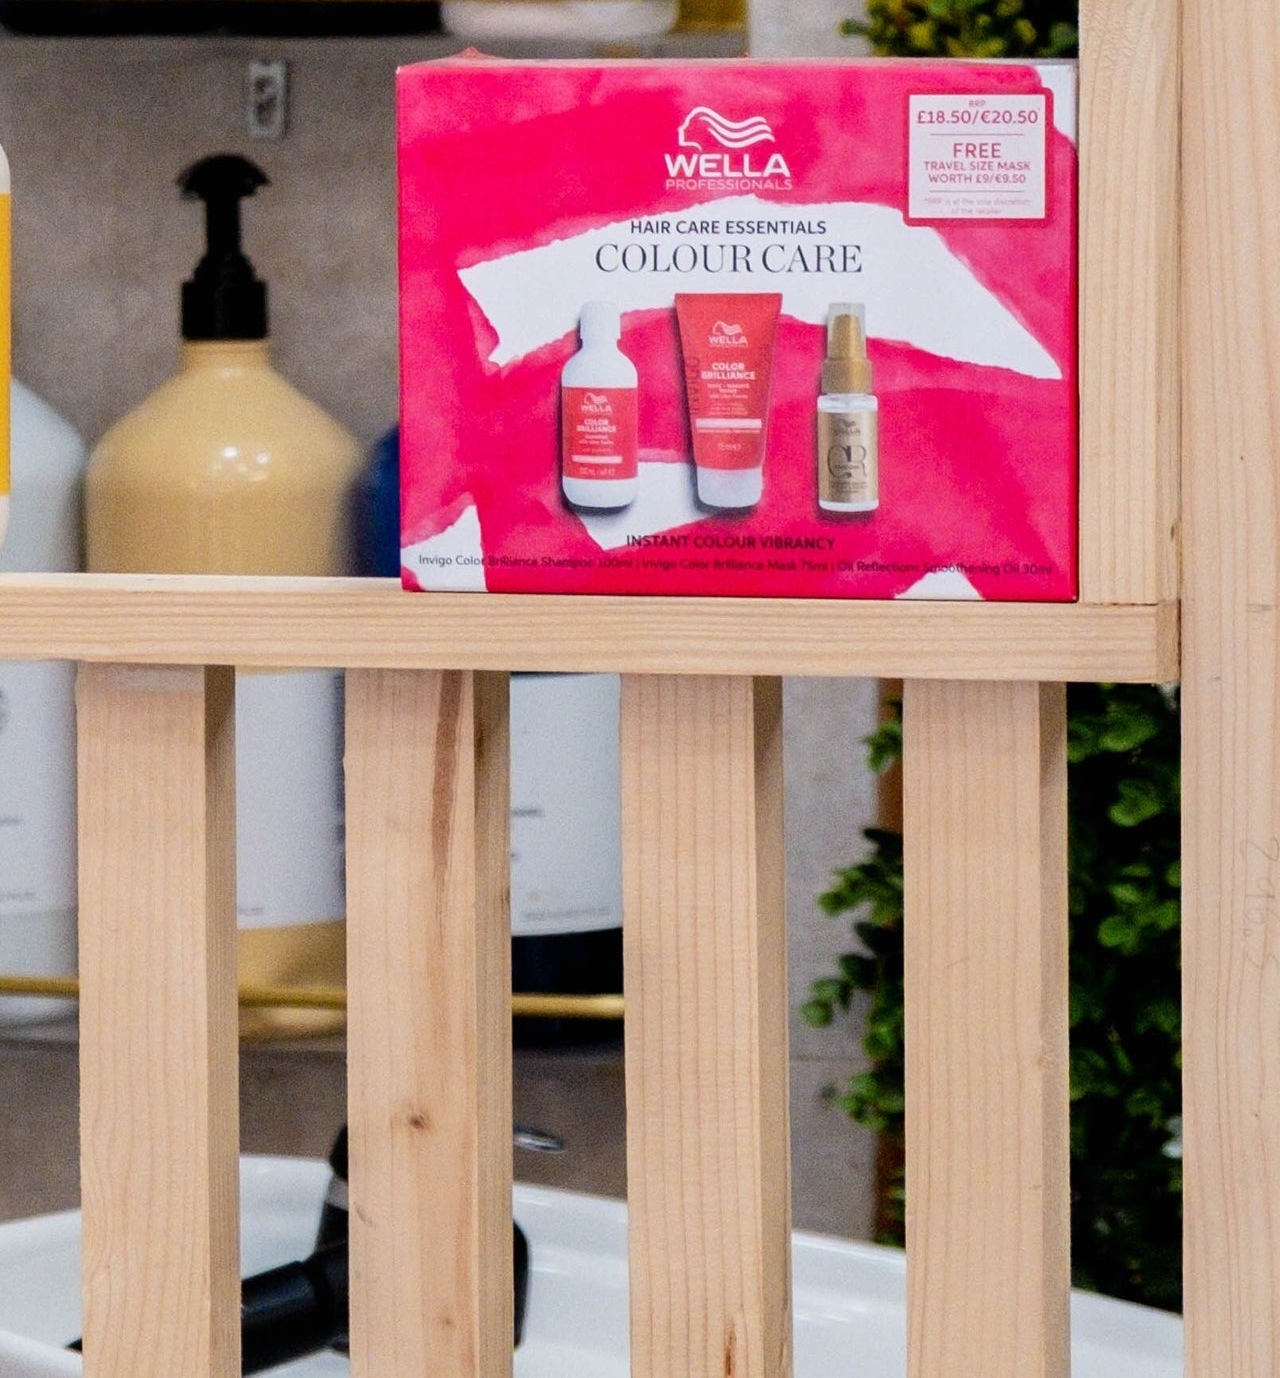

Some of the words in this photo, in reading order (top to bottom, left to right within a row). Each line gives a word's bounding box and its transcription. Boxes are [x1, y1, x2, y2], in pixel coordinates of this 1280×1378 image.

[952, 142, 1002, 159] FREE
[664, 153, 791, 178] WELLA
[924, 160, 966, 171] TRAVEL
[970, 160, 994, 171] SIZE
[997, 160, 1031, 171] MASK
[665, 178, 793, 191] PROFESSIONALS
[928, 173, 972, 184] WORTH
[975, 173, 1027, 185] £9/€9.50
[630, 219, 672, 235] HAIR
[676, 219, 721, 235] CARE
[725, 220, 827, 235] ESSENTIALS
[595, 243, 752, 273] COLOUR
[761, 244, 863, 273] CARE
[708, 335, 748, 345] WELLA
[711, 362, 745, 371] COLOR
[701, 371, 756, 380] BRILLIANCE
[581, 404, 613, 412] WELLA
[626, 534, 689, 548] INSTANT
[693, 535, 757, 550] COLOUR
[760, 536, 836, 550] VIBRANCY
[419, 554, 453, 569] Invigo
[455, 554, 486, 567] Color
[856, 560, 919, 573] Reflections
[922, 562, 1001, 577] Smoothening
